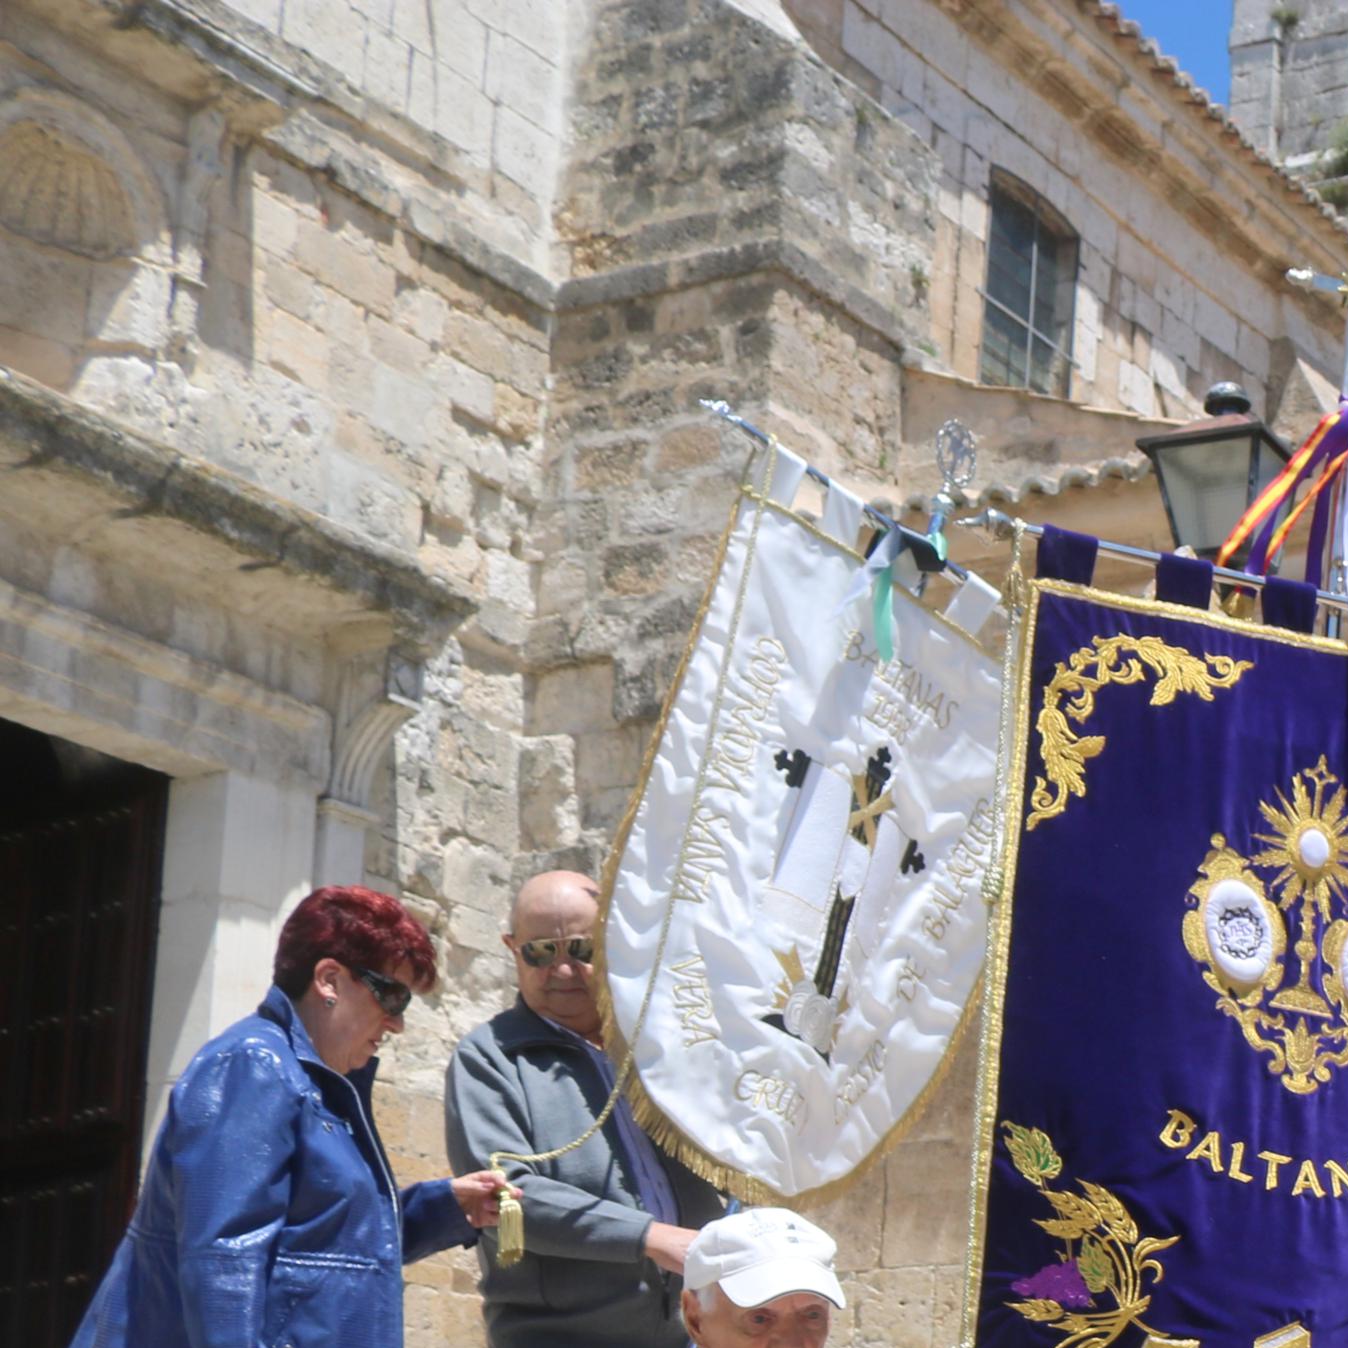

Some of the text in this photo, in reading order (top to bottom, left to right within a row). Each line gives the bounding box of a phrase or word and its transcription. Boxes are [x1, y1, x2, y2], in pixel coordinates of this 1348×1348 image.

[671, 810, 731, 905] SANTA
[920, 797, 996, 941] BALAGUER
[670, 954, 721, 1048] VERA
[896, 953, 927, 1002] DE
